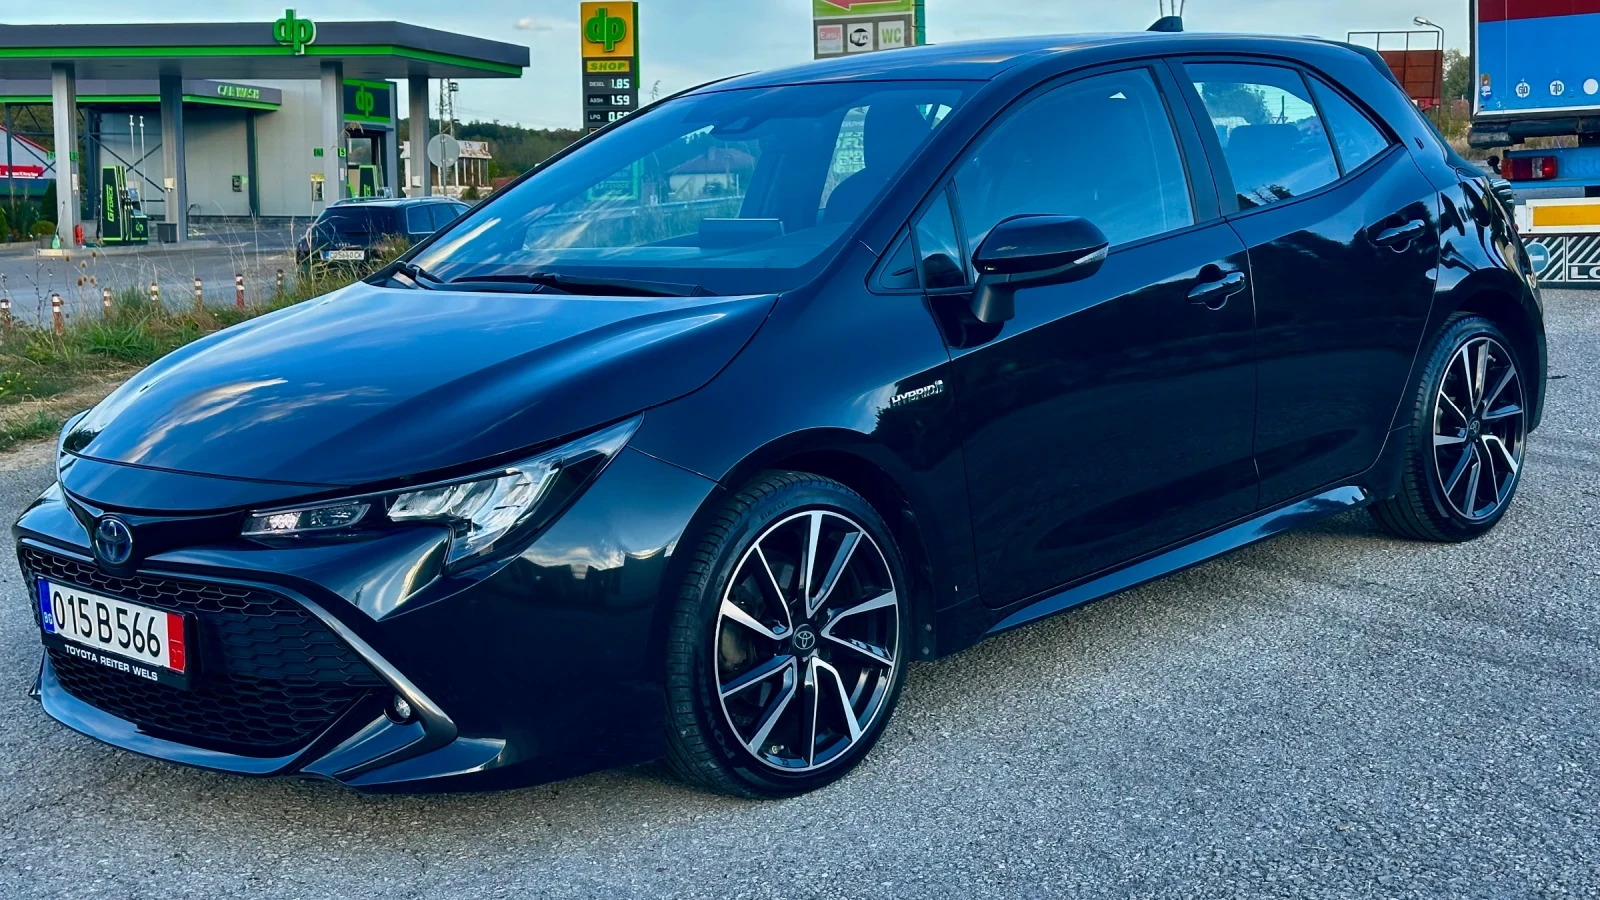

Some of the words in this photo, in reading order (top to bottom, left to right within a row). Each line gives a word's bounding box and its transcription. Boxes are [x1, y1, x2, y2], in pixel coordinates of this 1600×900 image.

[273, 9, 316, 54] dp
[586, 8, 626, 51] dp
[881, 28, 902, 44] WC
[590, 62, 626, 71] SHOP
[611, 78, 630, 89] 1.85
[217, 85, 235, 97] CAR
[236, 87, 260, 99] WASH
[355, 84, 375, 118] dp
[611, 95, 630, 105] 1.59
[43, 611, 54, 625] BG
[64, 644, 98, 663] TOYOTA
[100, 655, 130, 673] REITER
[132, 665, 158, 682] WELS
